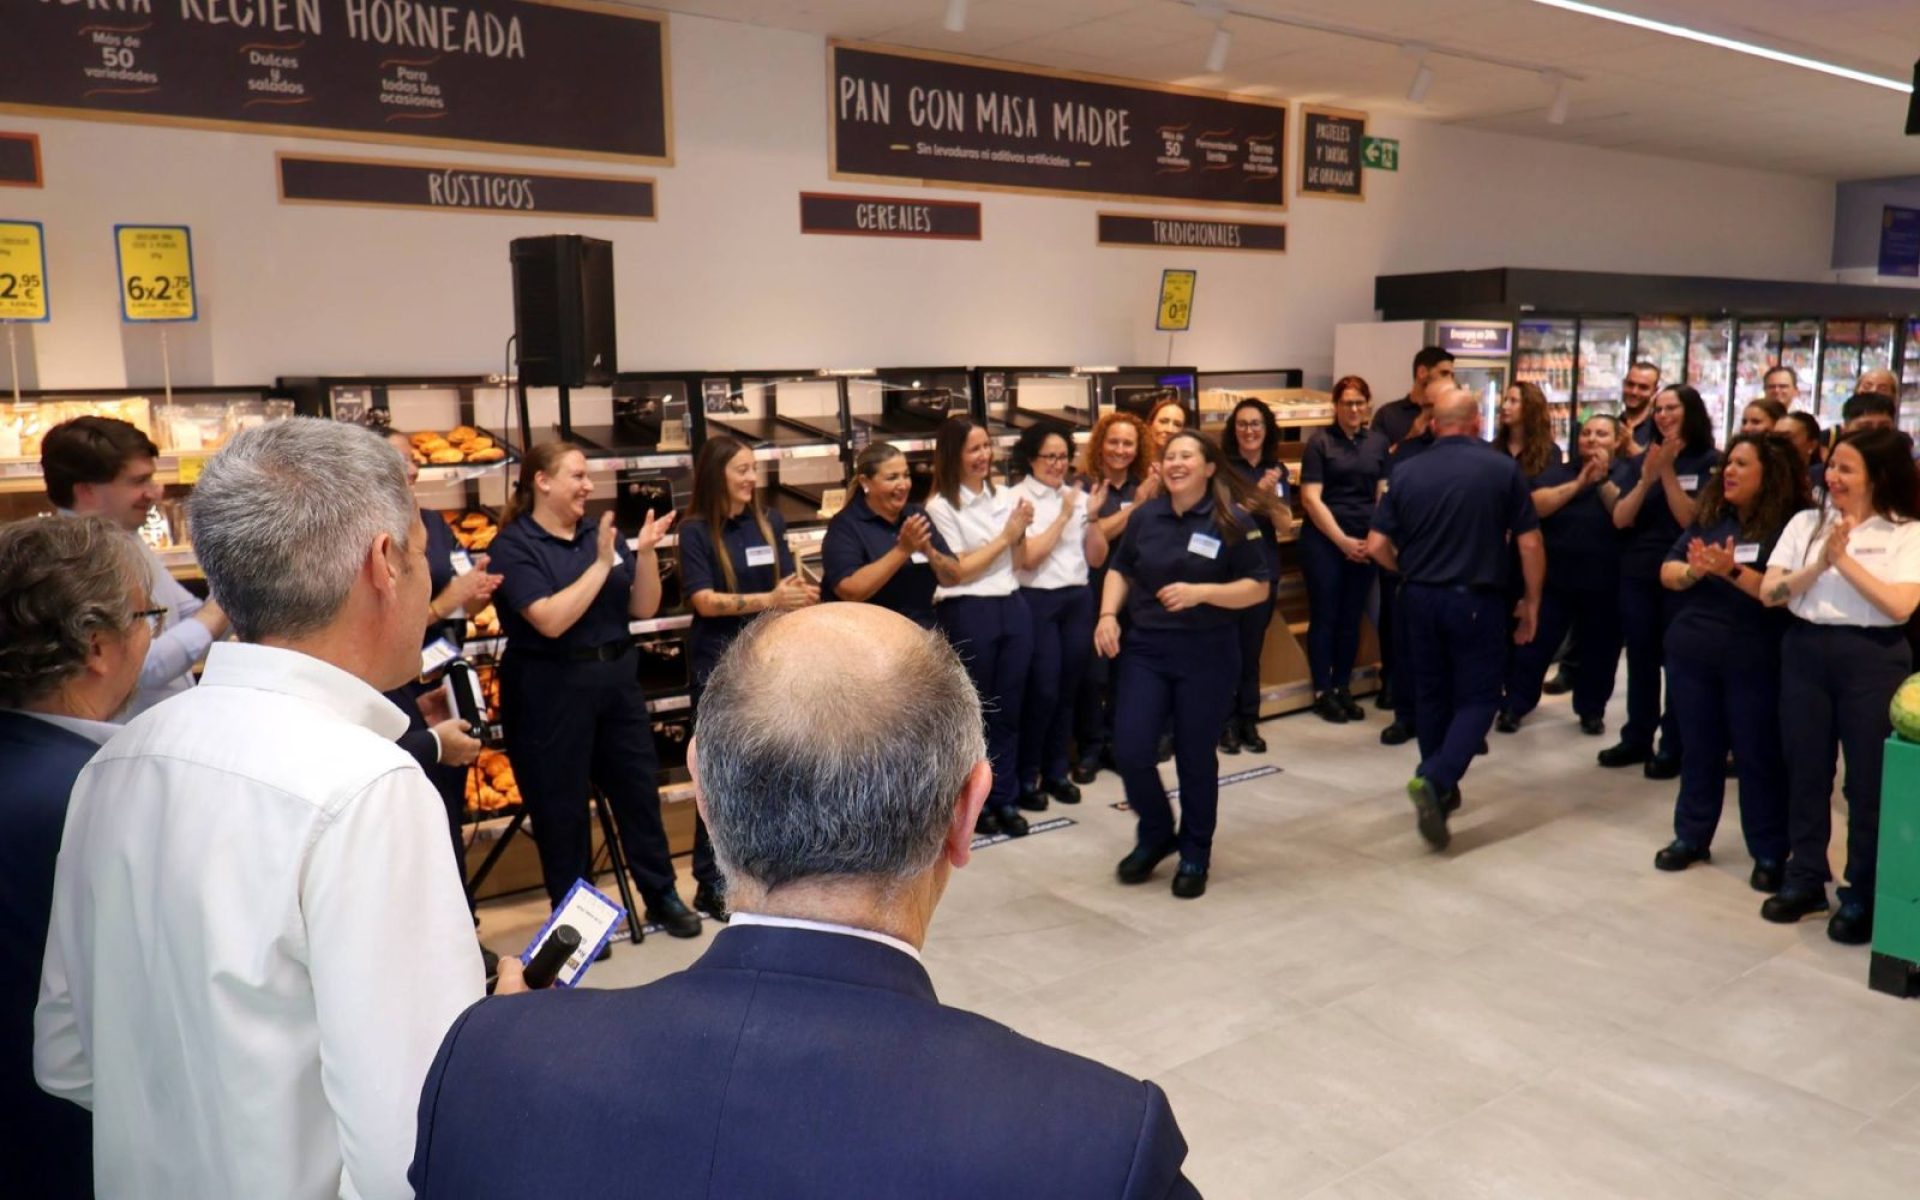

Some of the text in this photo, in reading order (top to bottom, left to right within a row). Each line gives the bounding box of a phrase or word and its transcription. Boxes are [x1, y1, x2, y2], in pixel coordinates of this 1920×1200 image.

[347, 0, 525, 58] HORNEADA
[123, 36, 140, 48] de
[102, 48, 134, 68] 50
[250, 51, 298, 69] Dulces
[84, 67, 158, 83] variedades
[270, 69, 281, 82] y
[397, 67, 427, 82] Para
[248, 79, 304, 95] salados
[380, 93, 444, 108] ocasiones
[840, 76, 1131, 147] PAN CON MASA MADRE
[1316, 122, 1350, 142] PASTELES
[916, 142, 1071, 168] Sin levaduras ni aditivos artificiales
[1165, 141, 1181, 156] 50
[1316, 146, 1322, 160] Y
[1308, 167, 1319, 183] DE
[428, 169, 535, 209] RÚSTICOS
[856, 203, 932, 232] CEREALES
[1152, 220, 1241, 247] TRADICIONALES
